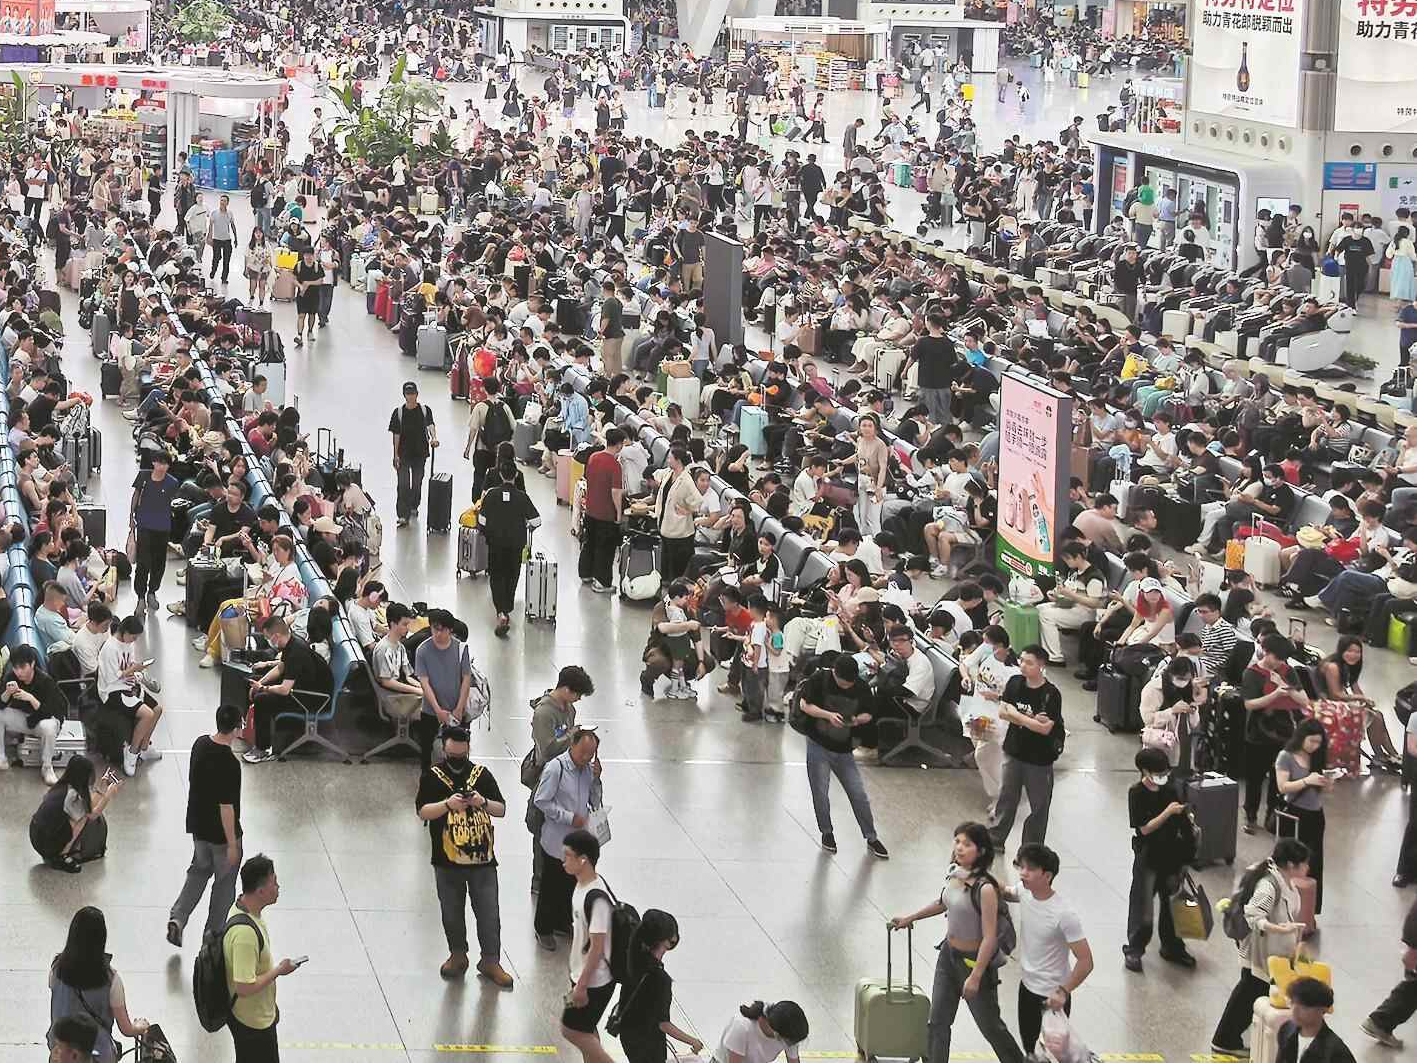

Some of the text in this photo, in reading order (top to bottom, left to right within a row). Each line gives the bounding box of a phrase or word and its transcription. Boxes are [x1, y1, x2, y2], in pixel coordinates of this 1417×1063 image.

[1202, 10, 1293, 35] 助力青花郎脱颖而出
